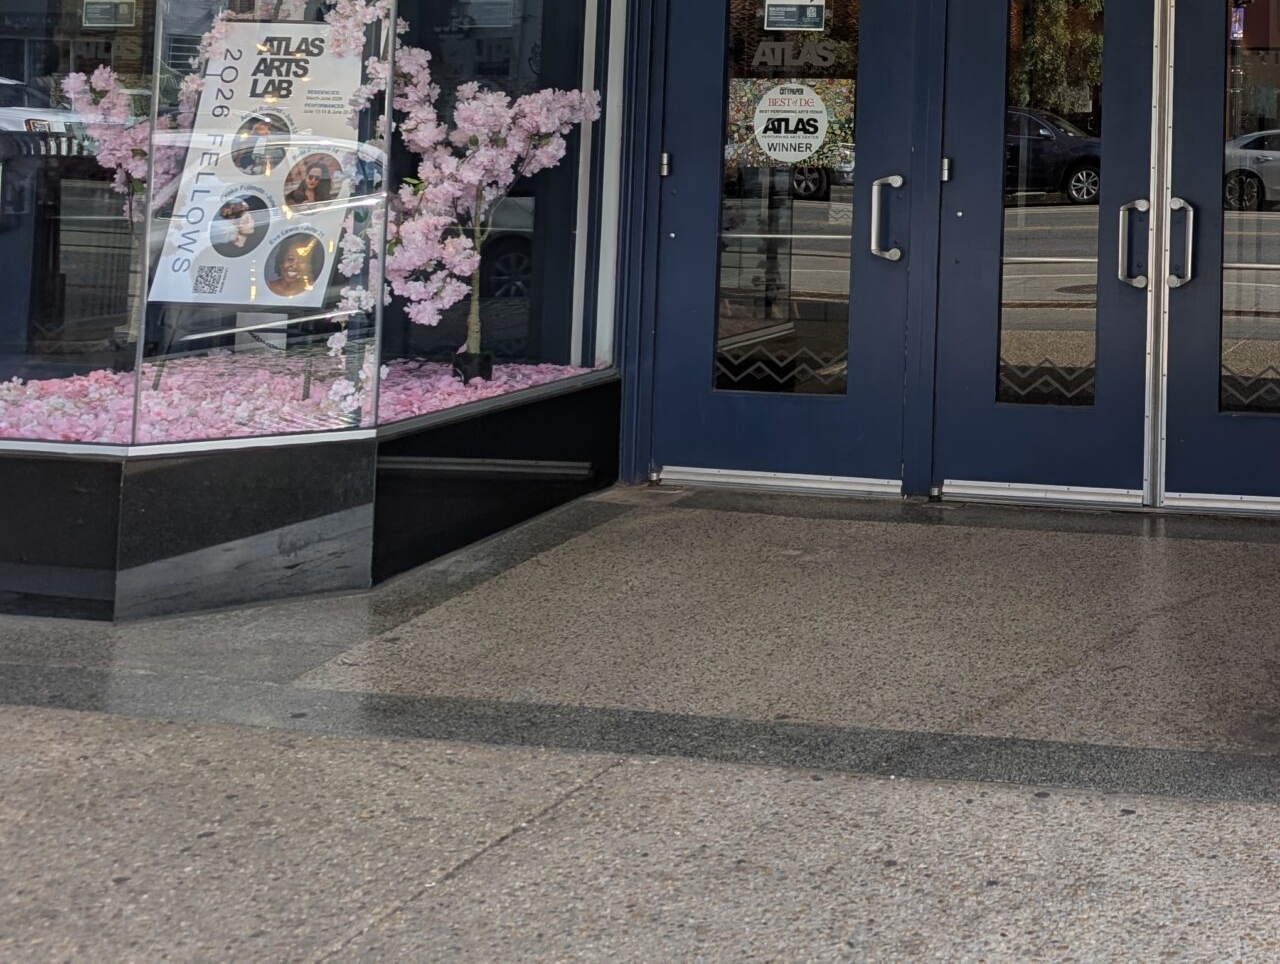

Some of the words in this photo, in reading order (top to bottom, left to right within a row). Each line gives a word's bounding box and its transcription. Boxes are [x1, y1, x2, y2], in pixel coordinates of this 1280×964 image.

[256, 36, 325, 57] ATLAS
[751, 41, 836, 67] ATLAS
[251, 57, 310, 78] ARTS
[211, 48, 243, 118] 2026
[249, 79, 293, 99] LAB
[768, 98, 791, 107] BEST
[762, 117, 819, 135] ATLAS
[767, 142, 813, 153] WINNER
